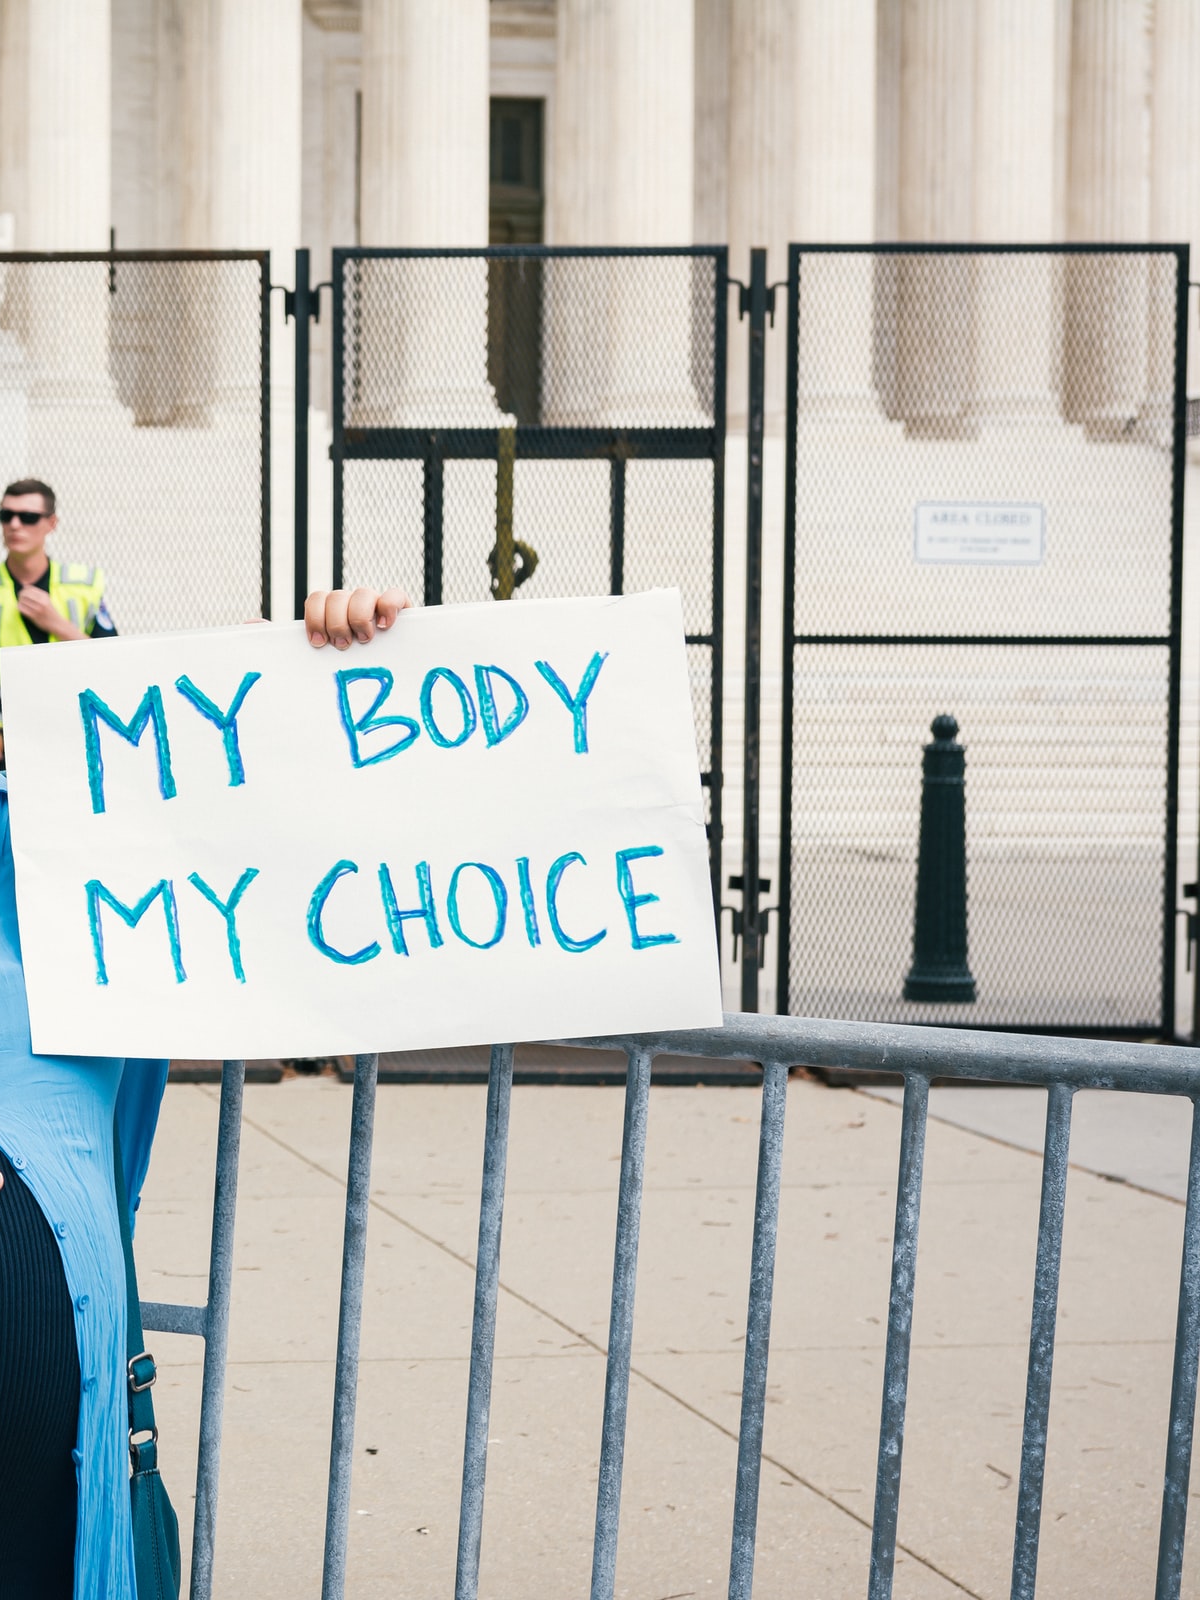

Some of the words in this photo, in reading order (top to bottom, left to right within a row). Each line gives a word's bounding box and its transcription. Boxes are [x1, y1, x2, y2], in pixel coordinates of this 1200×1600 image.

[78, 671, 262, 814] MY
[334, 651, 609, 769] BODY
[84, 867, 260, 986] MY
[306, 845, 682, 966] CHOICE
